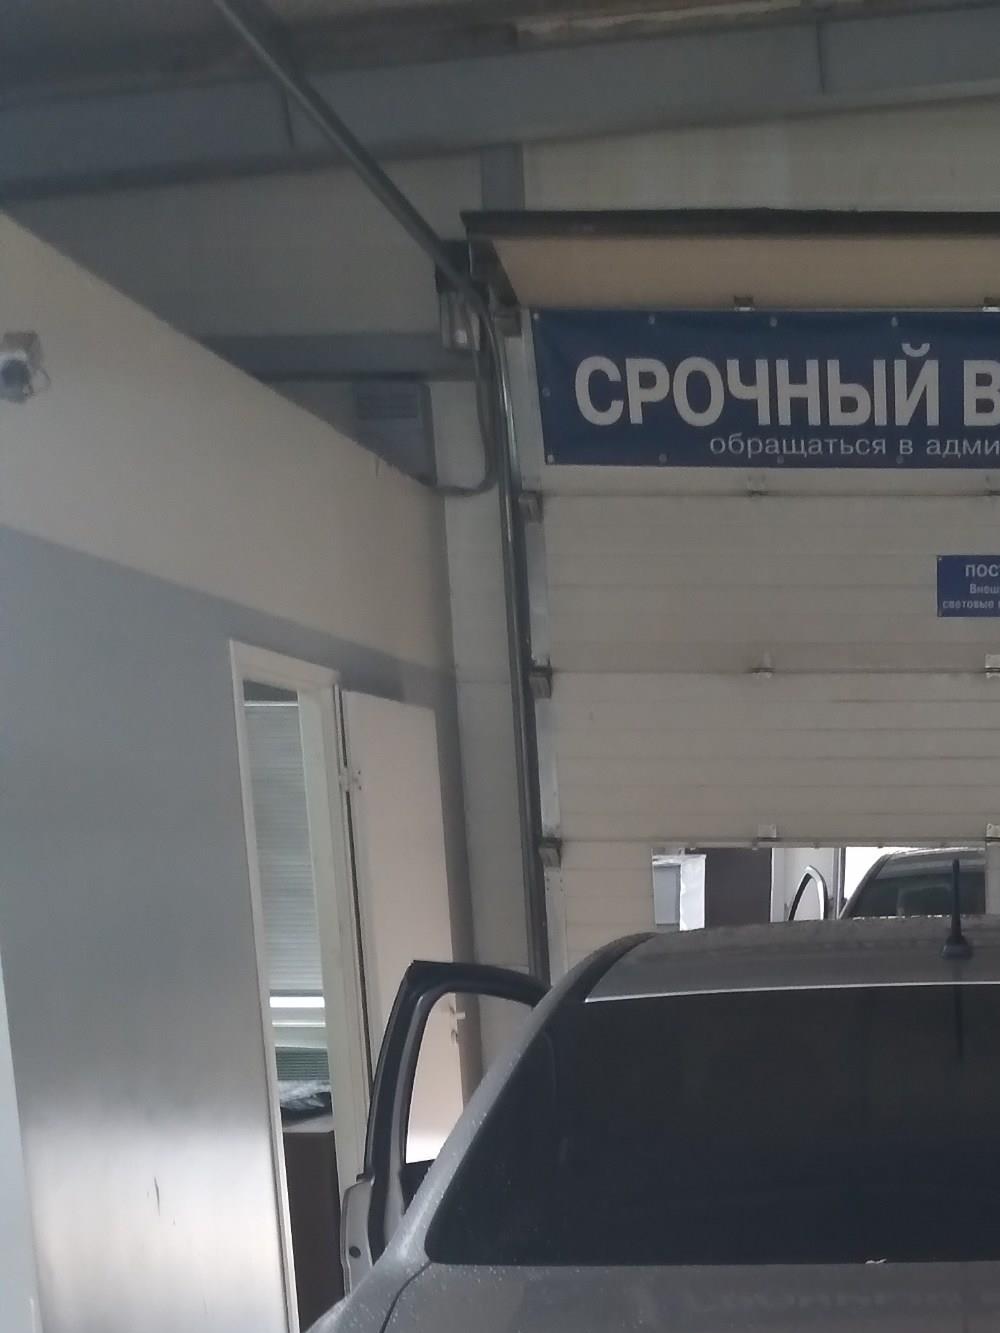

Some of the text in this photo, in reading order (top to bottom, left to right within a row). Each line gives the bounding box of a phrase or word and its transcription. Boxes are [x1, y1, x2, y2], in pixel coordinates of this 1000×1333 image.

[574, 342, 939, 427] СРОЧНЫЙ
[709, 434, 887, 461] обращаться
[898, 438, 914, 456] в
[942, 600, 994, 609] световые
